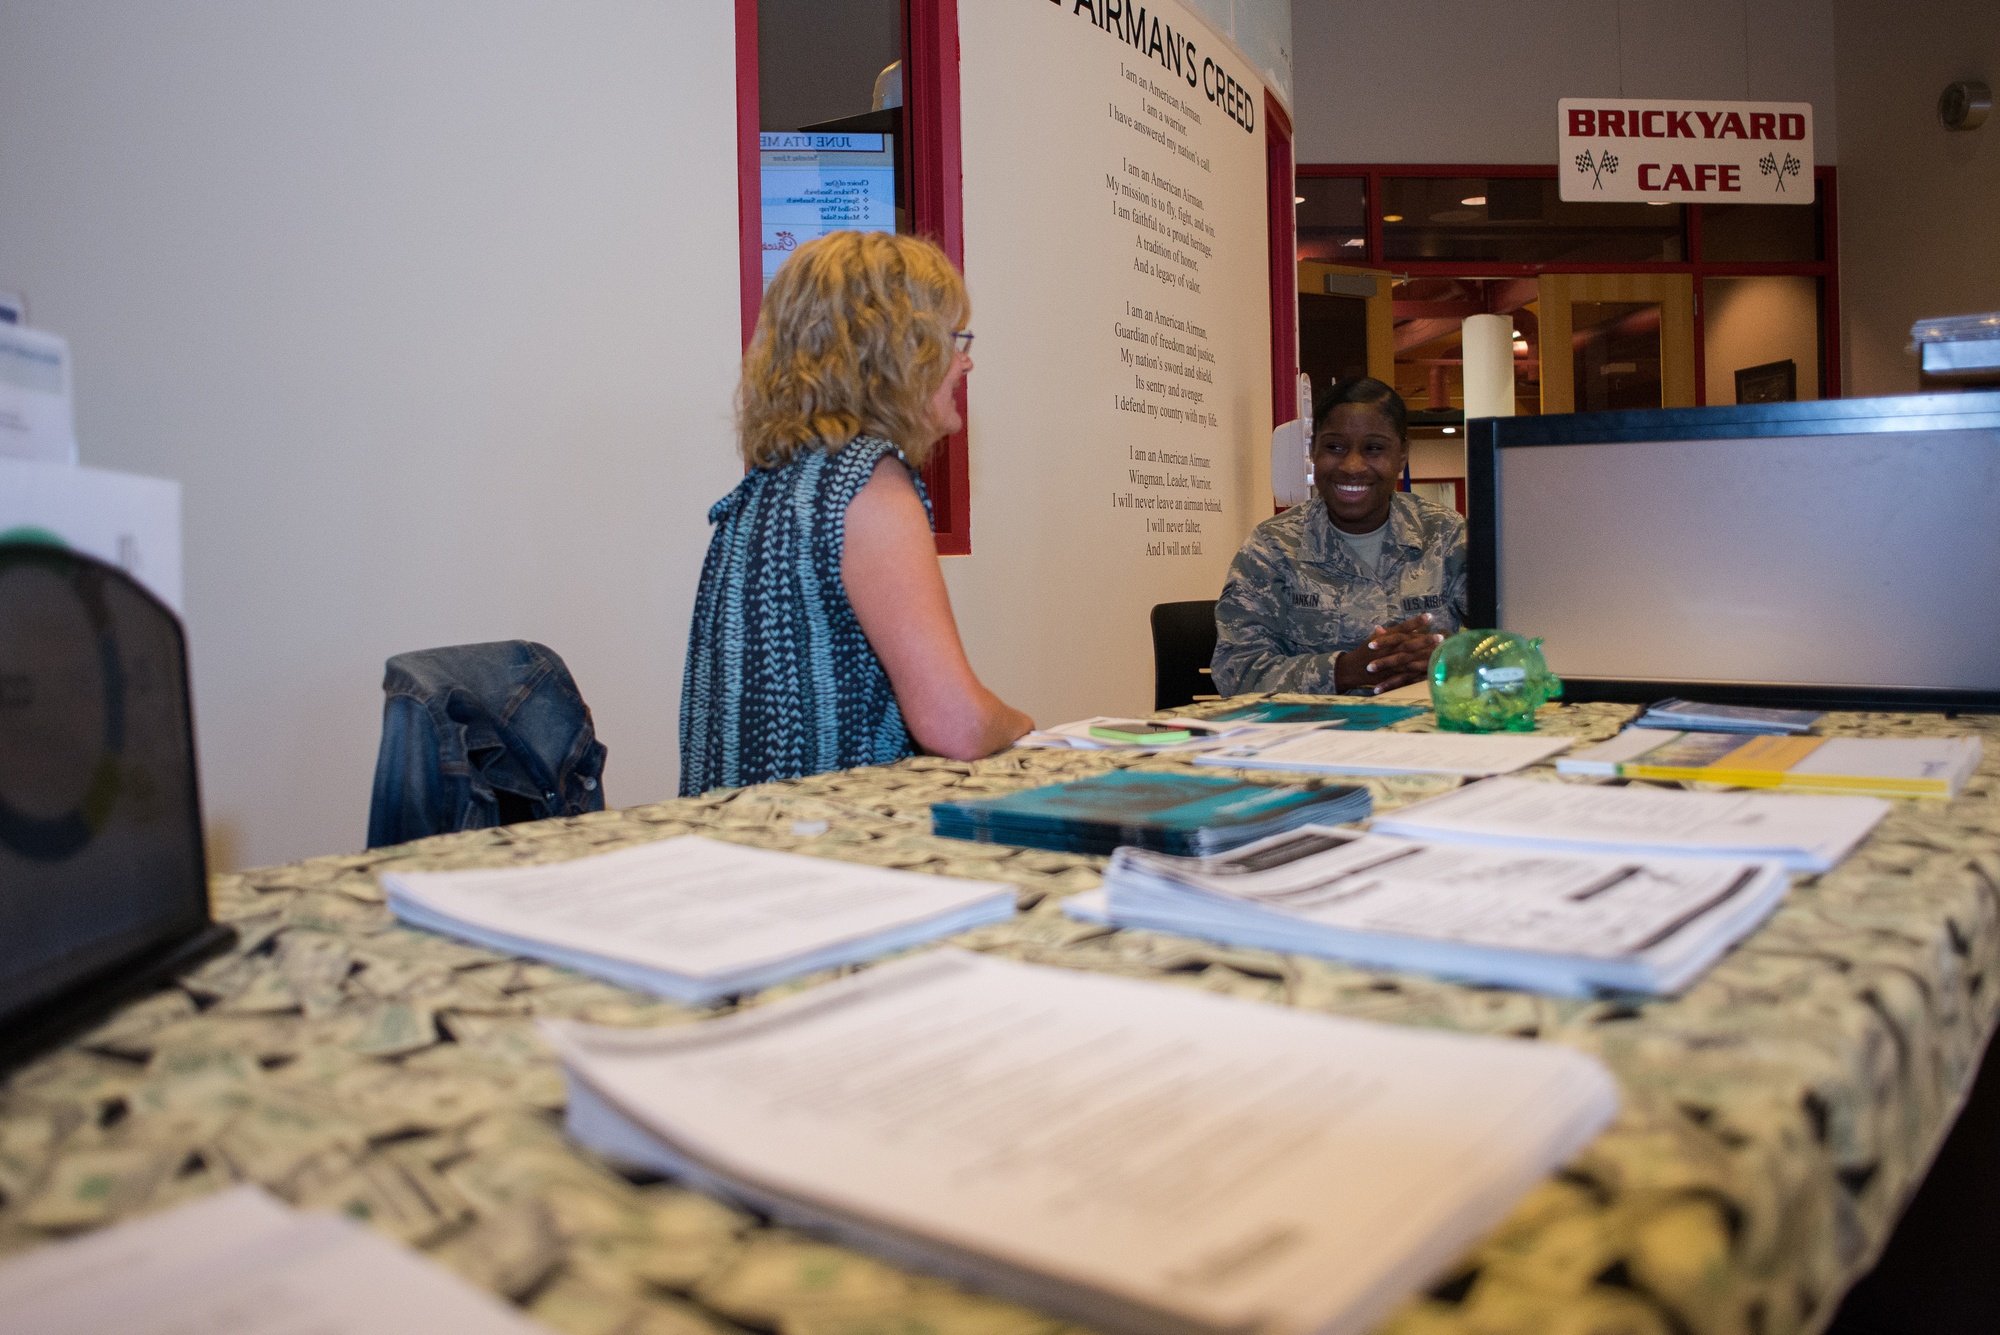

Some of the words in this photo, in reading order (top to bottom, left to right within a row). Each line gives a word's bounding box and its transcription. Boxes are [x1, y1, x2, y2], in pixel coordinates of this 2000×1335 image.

[1126, 70, 1137, 84] am
[1139, 77, 1148, 90] an
[1149, 80, 1180, 110] American
[1203, 57, 1254, 134] CREED
[1147, 104, 1157, 118] am
[1159, 112, 1163, 121] a
[1568, 109, 1805, 140] BRICKYARD
[1114, 106, 1132, 127] have
[1134, 119, 1165, 145] answered
[1167, 138, 1176, 154] my
[1128, 163, 1140, 178] am
[1141, 170, 1150, 182] an
[1151, 172, 1181, 198] American
[1637, 164, 1741, 192] CAFE
[1106, 174, 1120, 196] My
[1122, 183, 1150, 205] mission
[1152, 193, 1157, 208] is
[1158, 198, 1165, 212] to
[1194, 219, 1204, 232] and
[1118, 207, 1130, 220] am
[1132, 208, 1157, 232] faithful
[1158, 221, 1165, 234] to
[1167, 227, 1171, 237] a
[1172, 229, 1190, 246] proud
[1136, 234, 1142, 248] A
[1143, 239, 1172, 260] tradition
[1172, 250, 1180, 263] of
[1133, 256, 1148, 274] And
[1150, 265, 1154, 276] a
[1156, 264, 1176, 288] legacy
[1178, 274, 1185, 288] of
[1132, 306, 1143, 319] am
[1145, 310, 1153, 321] an
[1154, 310, 1184, 332] American
[1114, 322, 1149, 344] Guardian
[1150, 332, 1159, 346] of
[1160, 334, 1185, 354] freedom
[1186, 344, 1196, 357] and
[1121, 348, 1134, 368] My
[1164, 362, 1183, 376] sword
[1184, 365, 1195, 378] and
[1136, 375, 1145, 390] Its
[1146, 380, 1167, 398] sentry
[1168, 384, 1180, 397] and
[1121, 396, 1145, 414] defend
[1148, 404, 1158, 420] my
[1160, 406, 1184, 424] country
[1185, 408, 1198, 423] with
[1199, 413, 1207, 428] my
[1135, 449, 1146, 461] am
[1148, 451, 1156, 462] an
[1158, 449, 1188, 466] American
[1129, 469, 1165, 489] Wingman,
[1118, 493, 1133, 508] will
[1135, 498, 1155, 509] never
[1156, 495, 1173, 509] leave
[1175, 500, 1183, 510] an
[1184, 497, 1203, 511] airman
[1152, 518, 1165, 532] will
[1166, 523, 1184, 533] never
[1146, 542, 1160, 556] And
[1167, 542, 1179, 555] will
[1181, 544, 1190, 555] not
